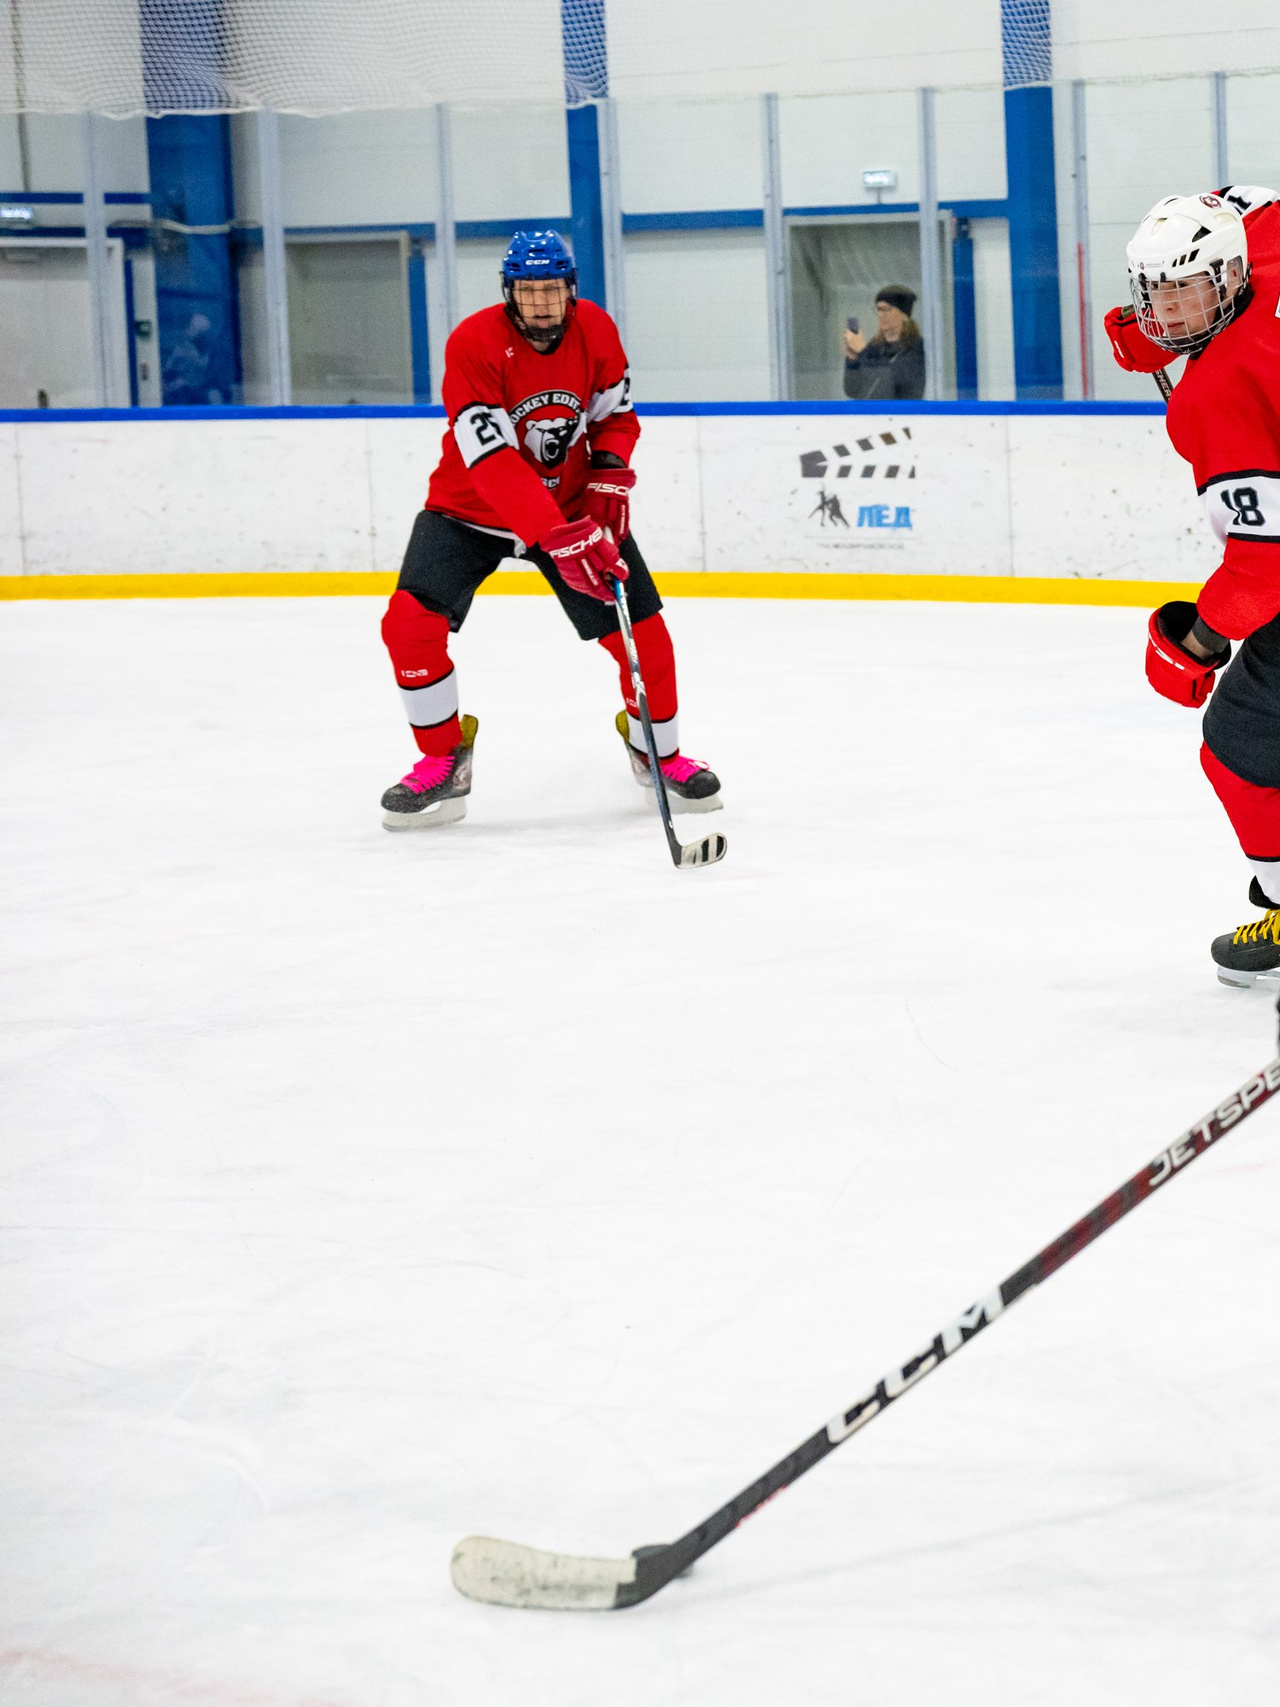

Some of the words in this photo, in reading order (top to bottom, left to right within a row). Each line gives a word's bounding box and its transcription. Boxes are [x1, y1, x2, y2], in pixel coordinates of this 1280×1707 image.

[510, 394, 550, 428] OCKEY
[552, 393, 581, 414] EDIT
[1220, 486, 1266, 527] 18
[826, 1283, 1003, 1443] CCM
